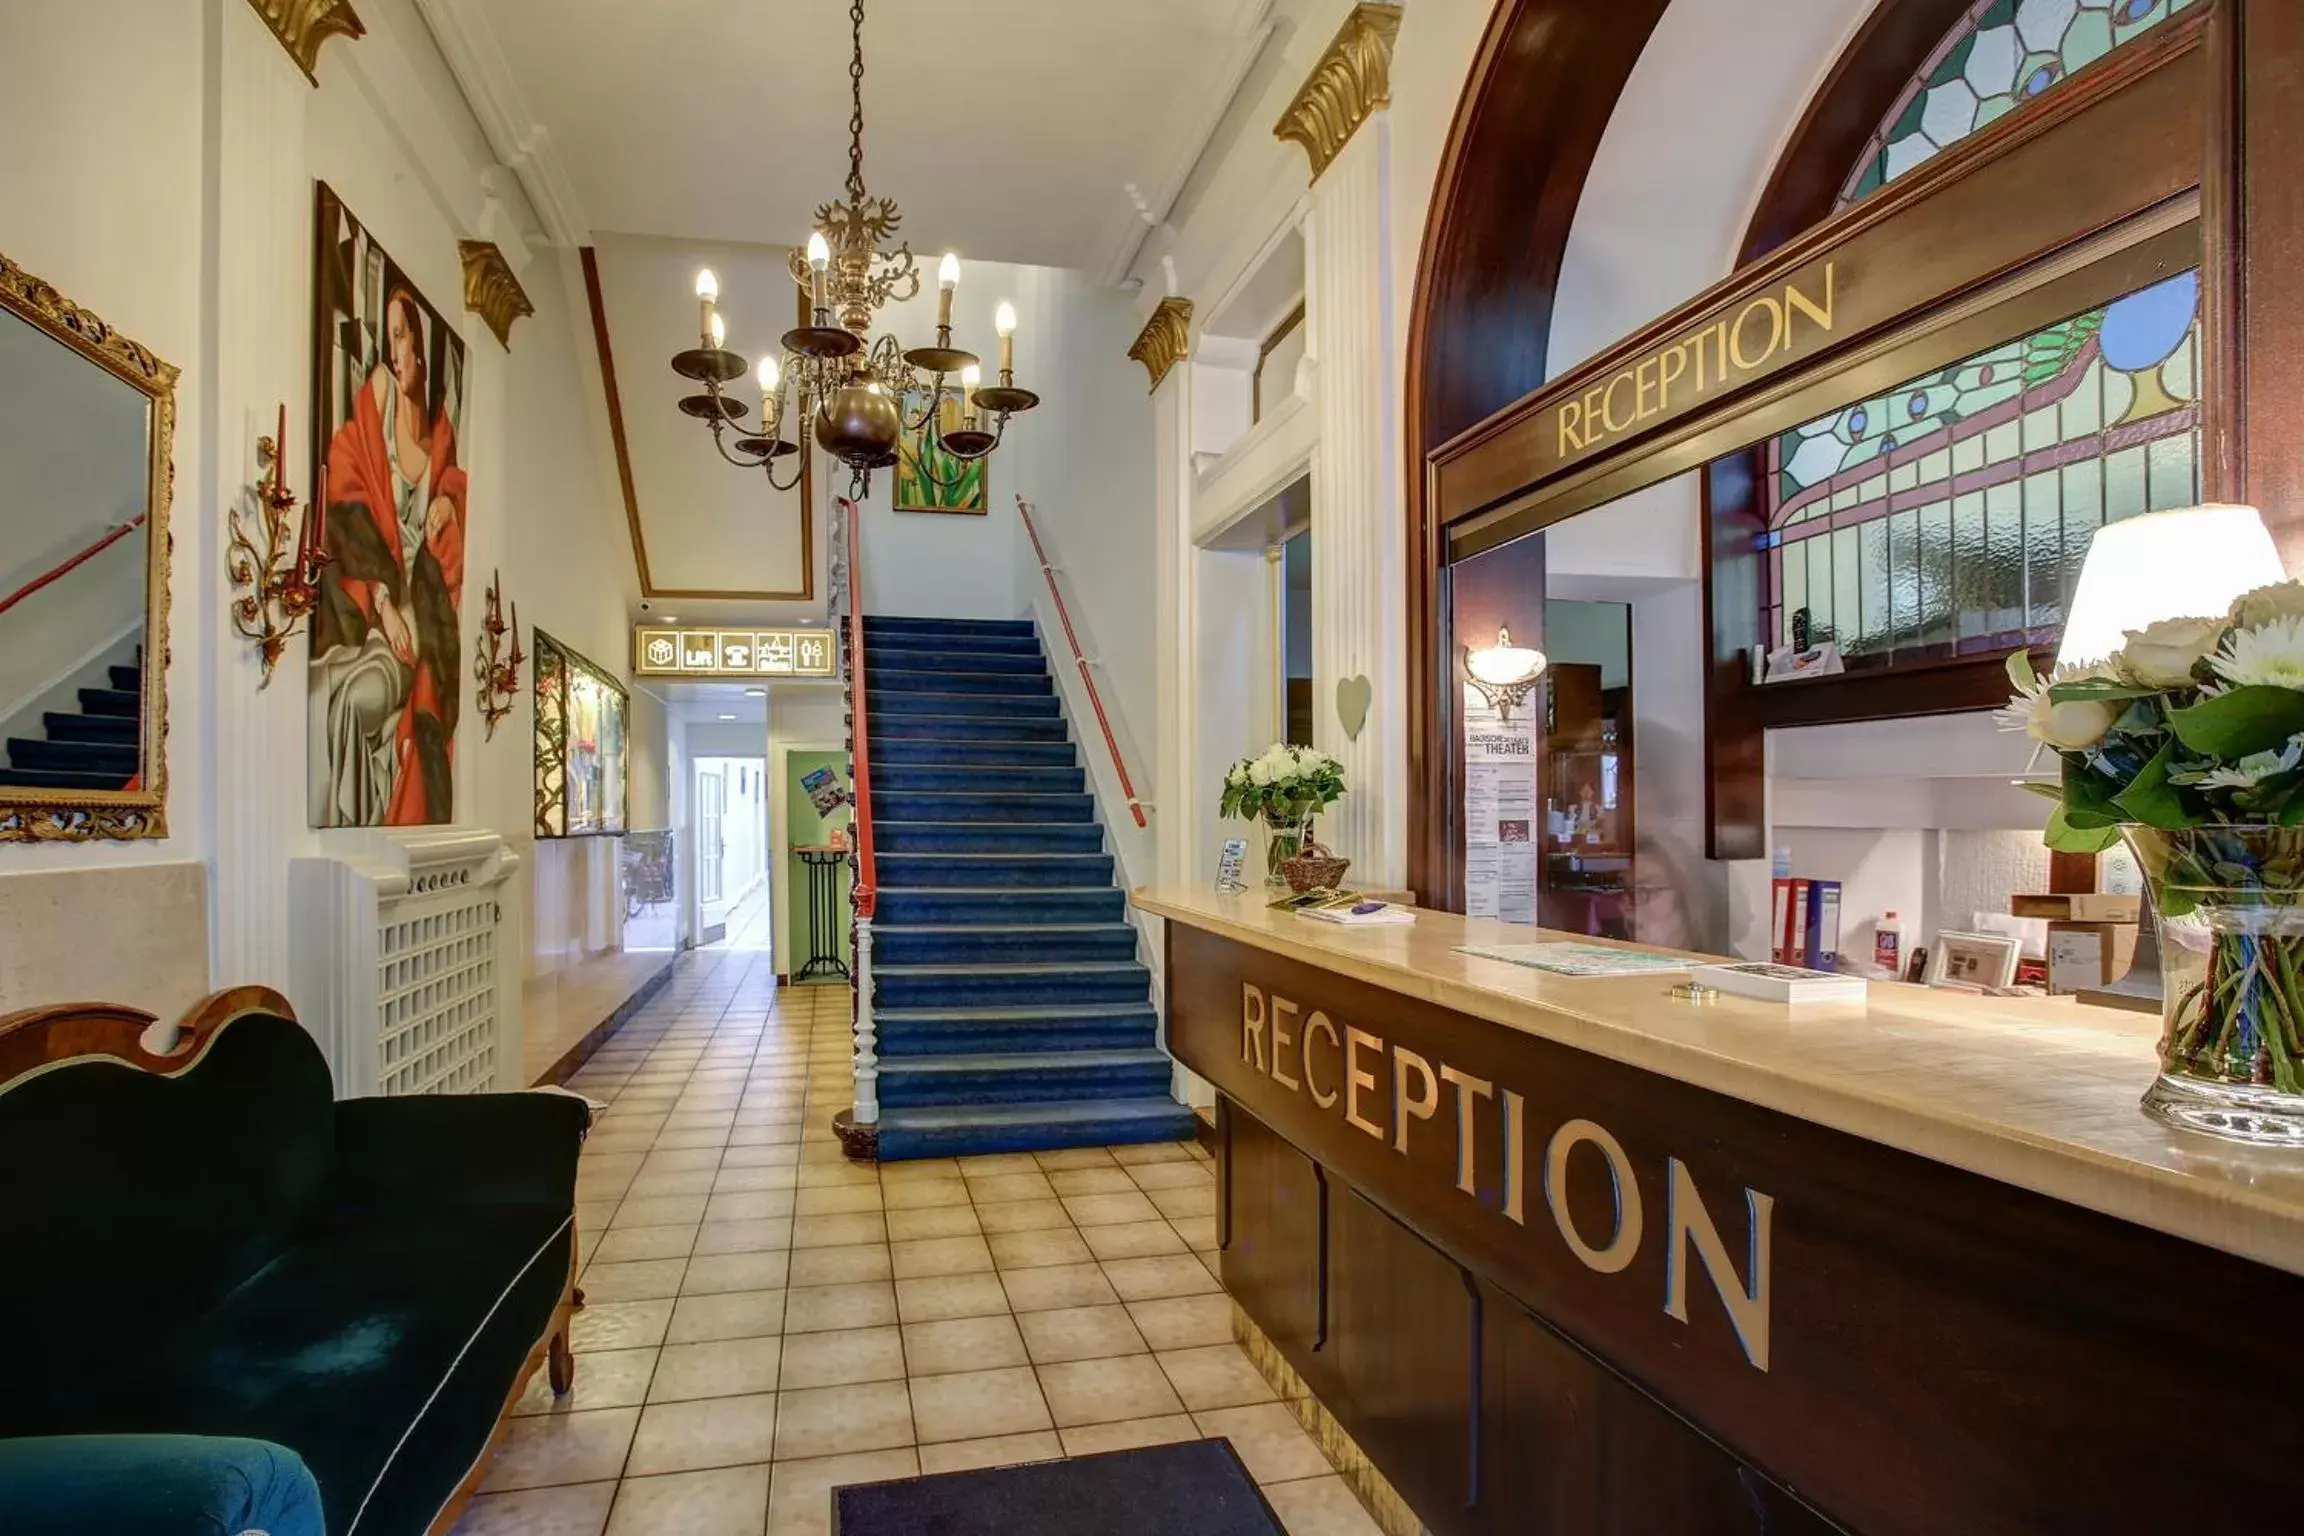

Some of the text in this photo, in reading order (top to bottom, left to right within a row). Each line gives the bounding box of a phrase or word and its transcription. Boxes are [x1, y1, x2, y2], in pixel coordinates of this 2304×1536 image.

[1558, 262, 1834, 459] RECEPTION
[1485, 743, 1529, 755] THEATER
[1240, 981, 1774, 1373] RECEPTION
